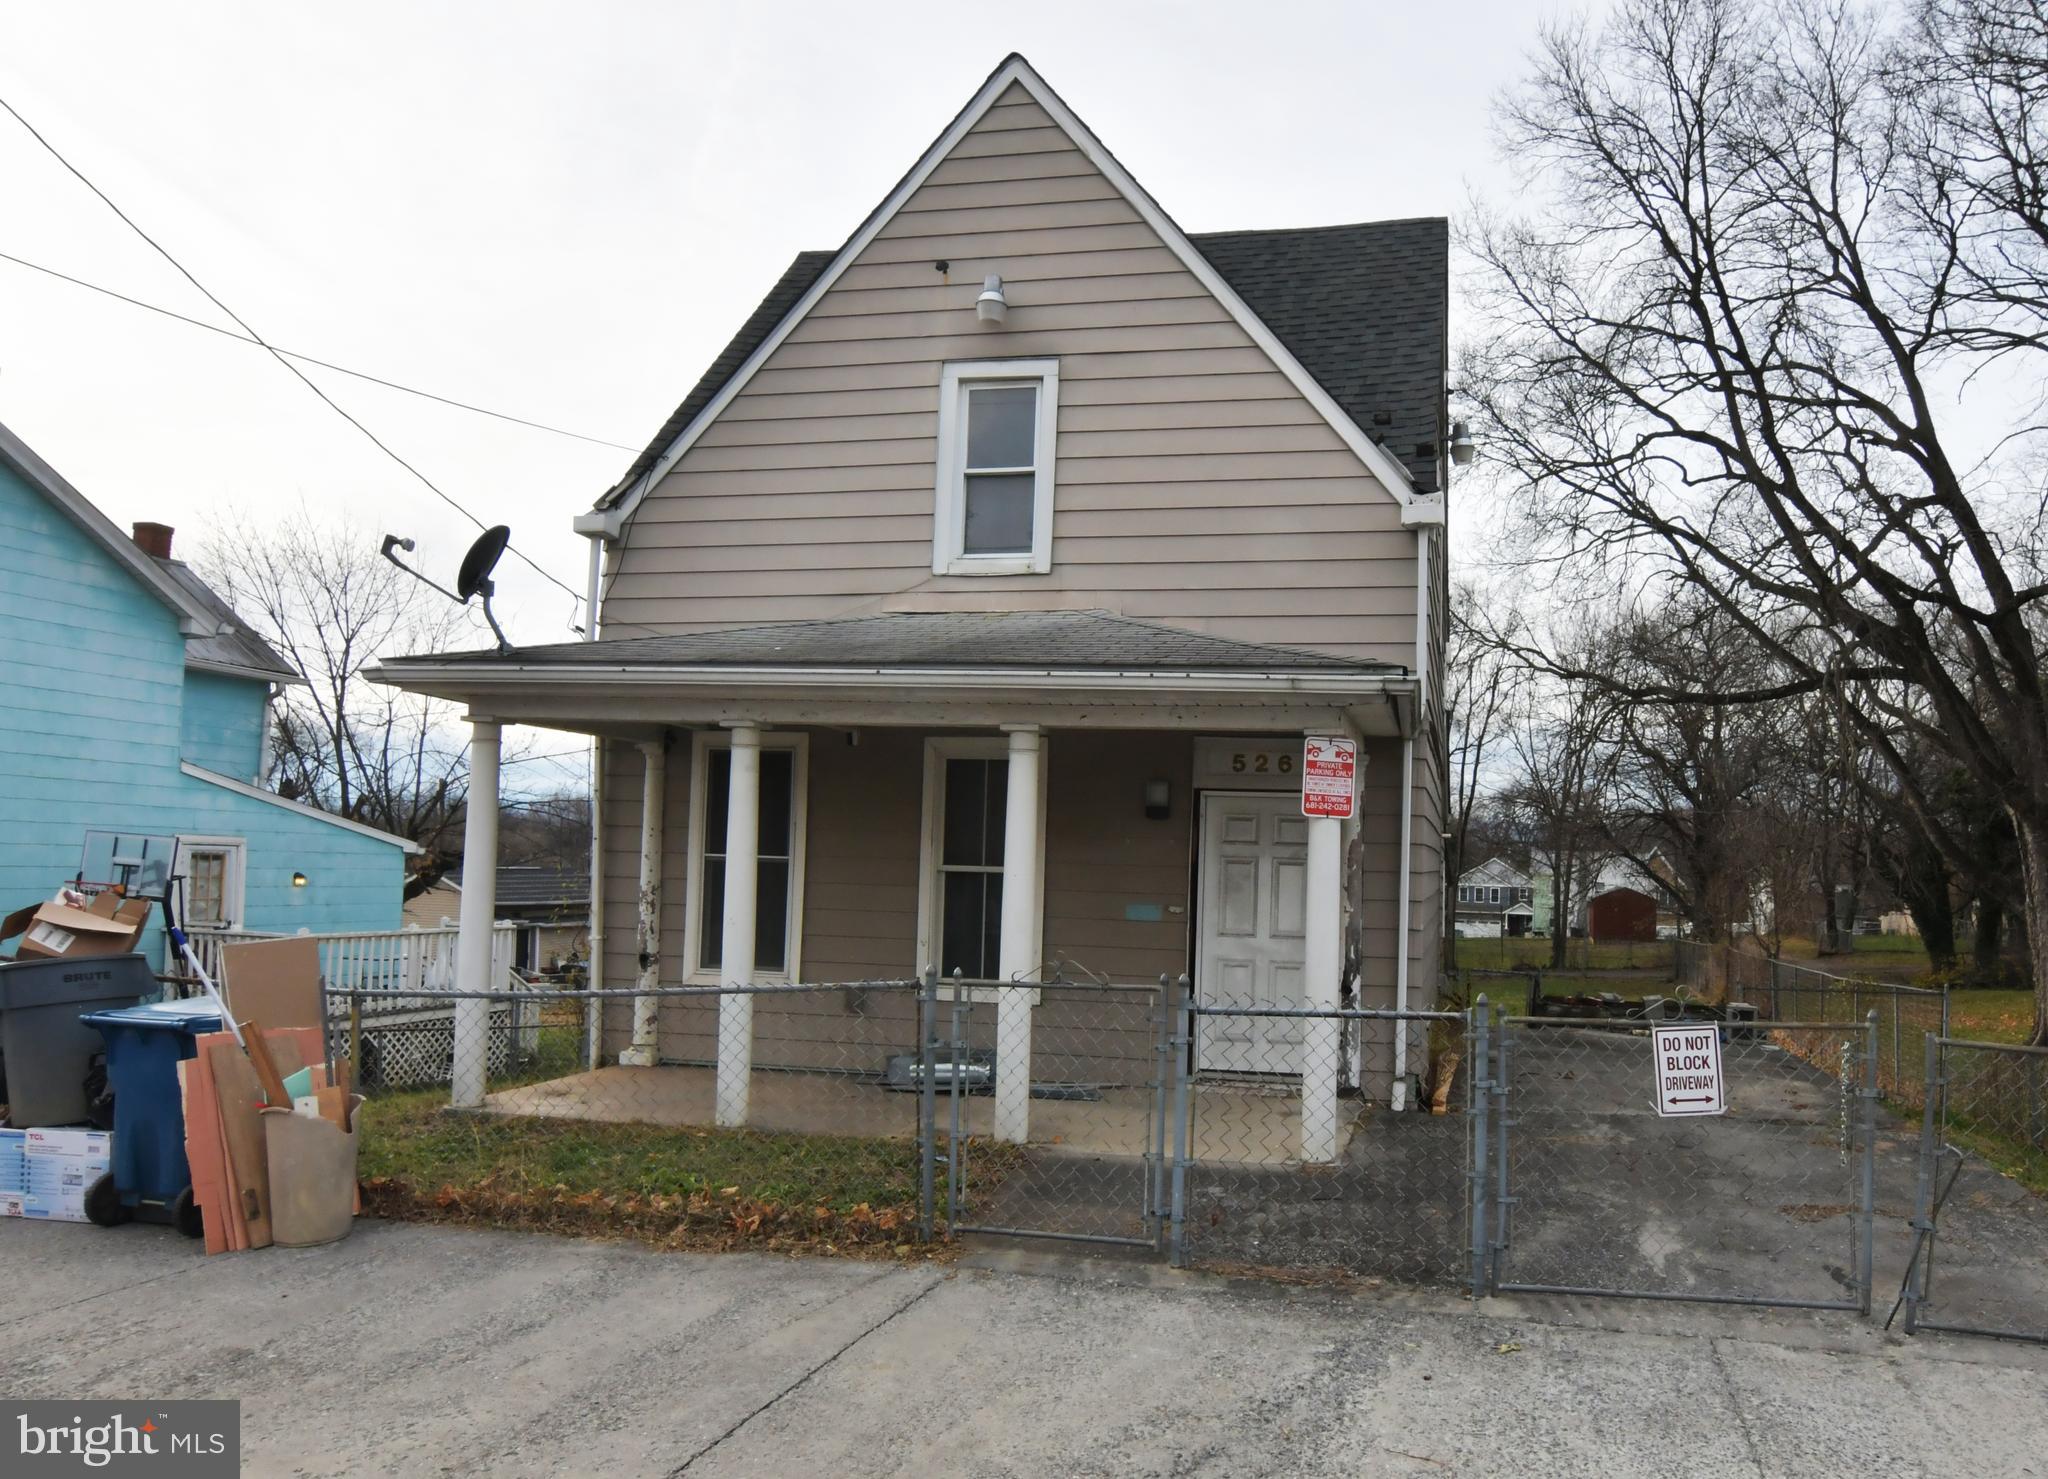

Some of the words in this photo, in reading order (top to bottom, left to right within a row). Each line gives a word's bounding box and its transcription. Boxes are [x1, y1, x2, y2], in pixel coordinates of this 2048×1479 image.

[1232, 753, 1292, 773] 526
[1306, 768, 1334, 776] PARKING
[1305, 801, 1350, 811] 681-242-0281
[63, 971, 112, 983] BRUTE
[1662, 1037, 1681, 1052] DO
[1685, 1036, 1711, 1051] NOT
[1666, 1055, 1711, 1071] BLOCK
[1665, 1075, 1714, 1091] DRIVEWAY
[29, 1133, 44, 1141] TCL
